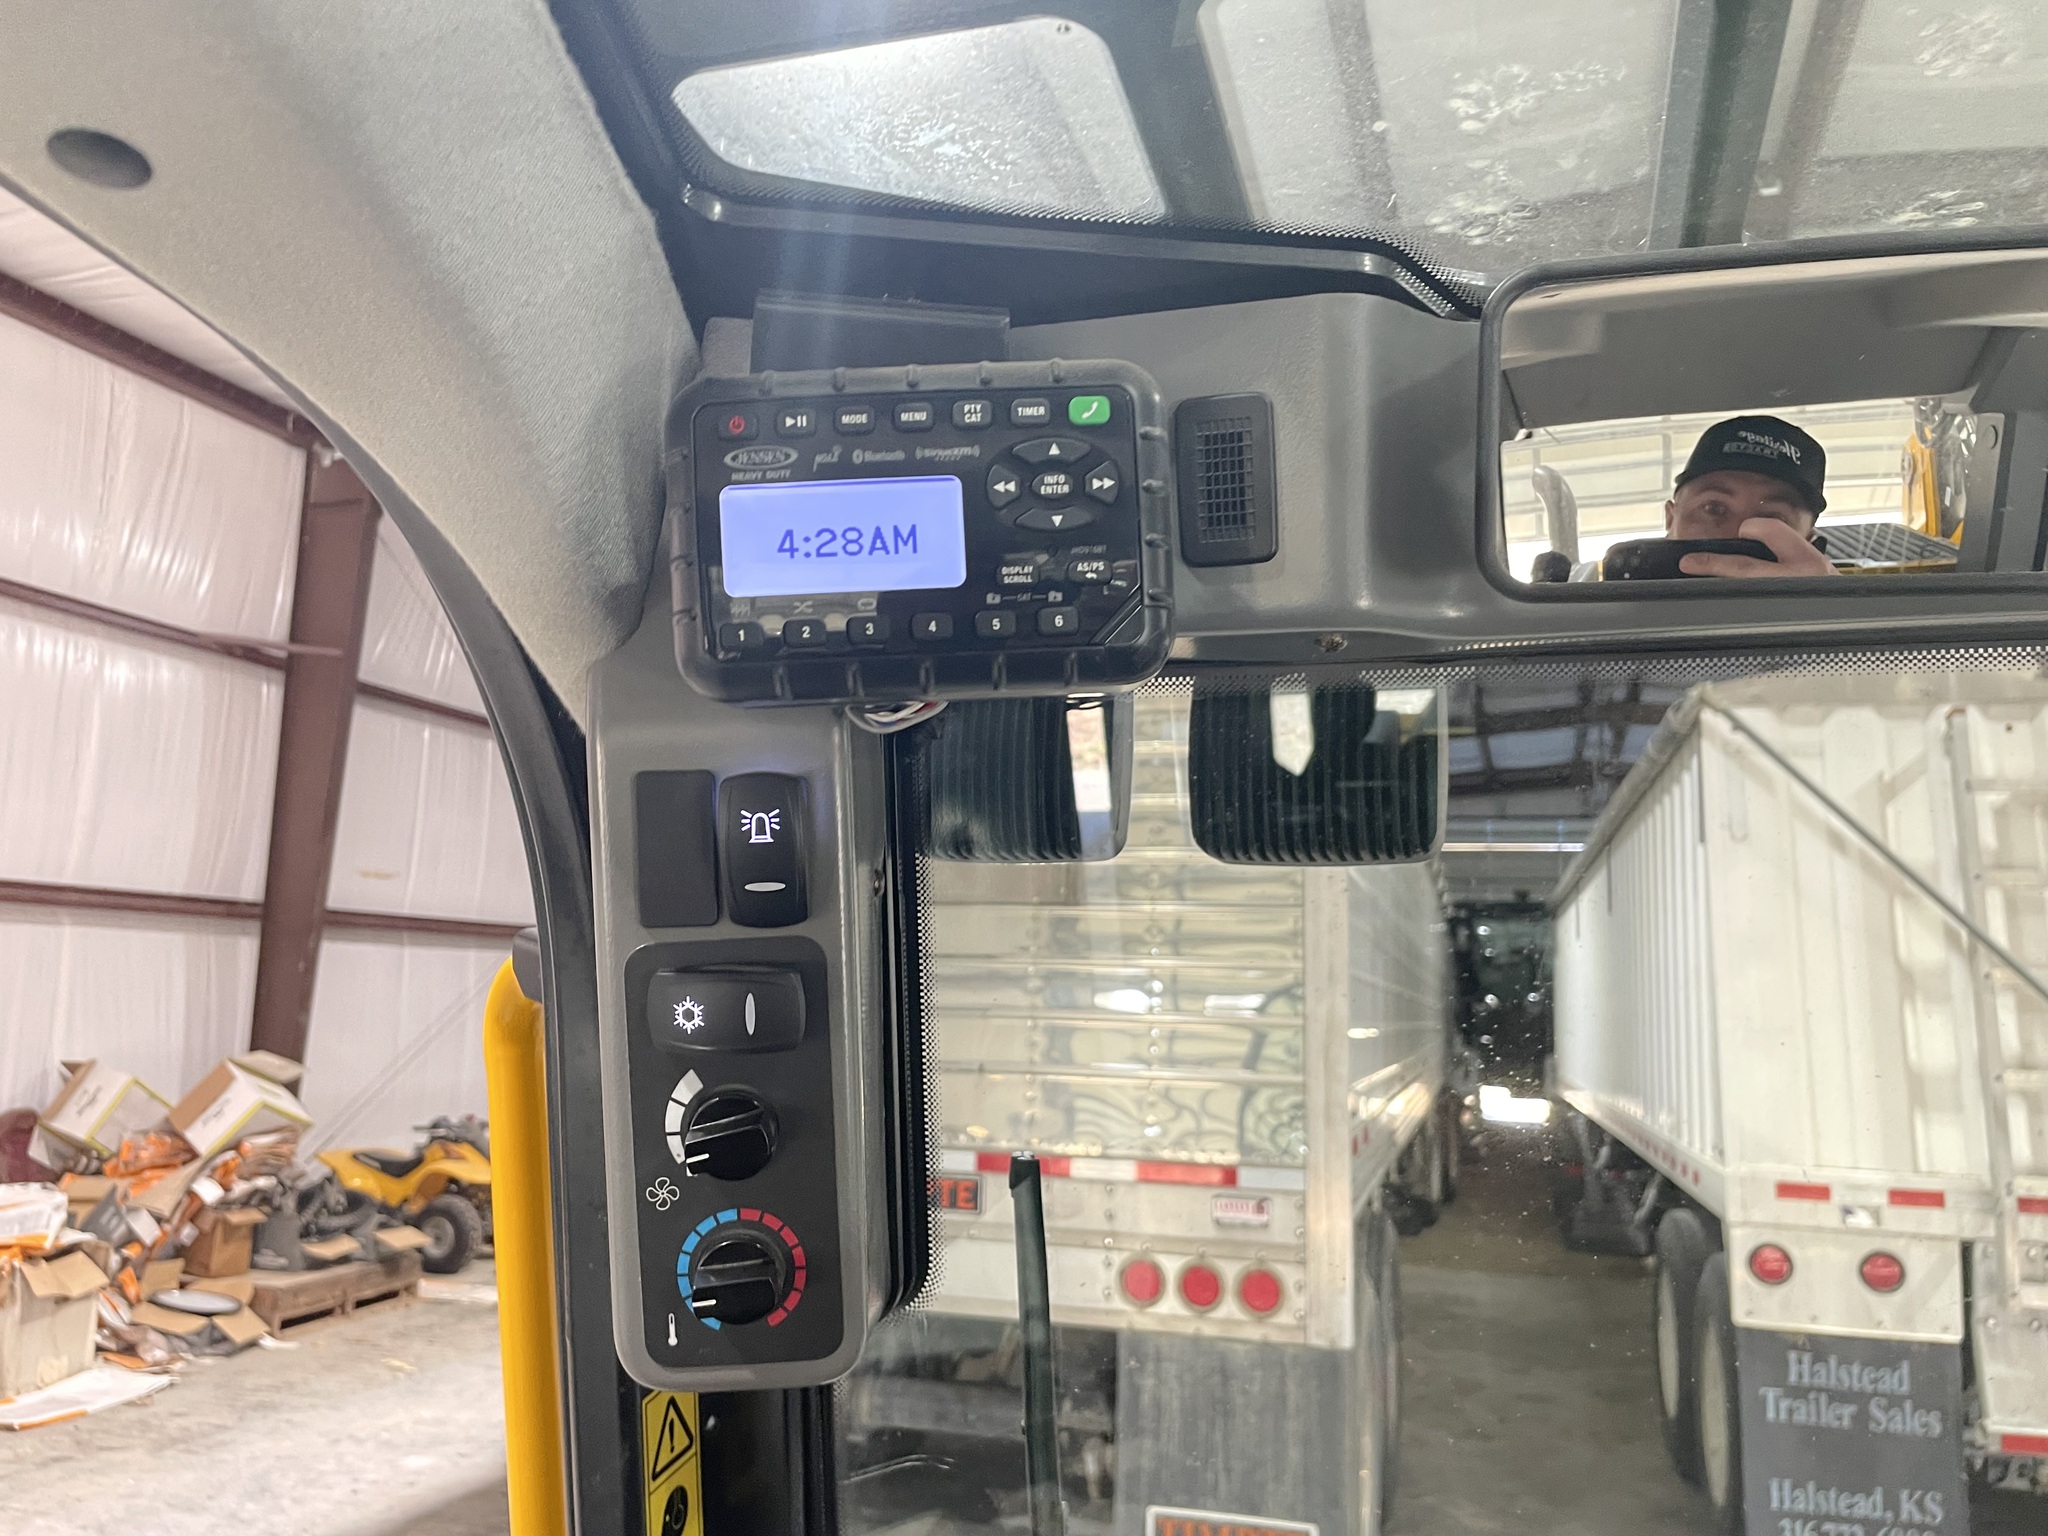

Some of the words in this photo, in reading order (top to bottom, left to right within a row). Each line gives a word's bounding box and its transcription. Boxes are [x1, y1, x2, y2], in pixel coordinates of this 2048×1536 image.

[963, 404, 982, 413] PTY
[1017, 406, 1046, 416] TIMER
[841, 413, 868, 424] MODE
[900, 411, 927, 422] MENU
[964, 412, 982, 423] CAT
[731, 471, 763, 481] HEAVY
[766, 469, 791, 479] DUTY
[1043, 474, 1066, 484] INFO
[1040, 484, 1070, 495] ENTER
[777, 524, 918, 559] 4:28AM
[1001, 565, 1034, 575] DISPLAY
[1076, 561, 1105, 571] AS/PS
[1003, 575, 1033, 584] SCROLL
[928, 620, 937, 632] 4
[992, 618, 1001, 630] 5
[1054, 615, 1064, 627] 6
[802, 626, 811, 638] 2
[865, 622, 874, 635] 3
[738, 629, 745, 641] 1
[1786, 1349, 1912, 1395] Halstead
[1759, 1386, 1857, 1430] Trailer
[1868, 1396, 1943, 1438] Sales
[1899, 1488, 1944, 1526] KS
